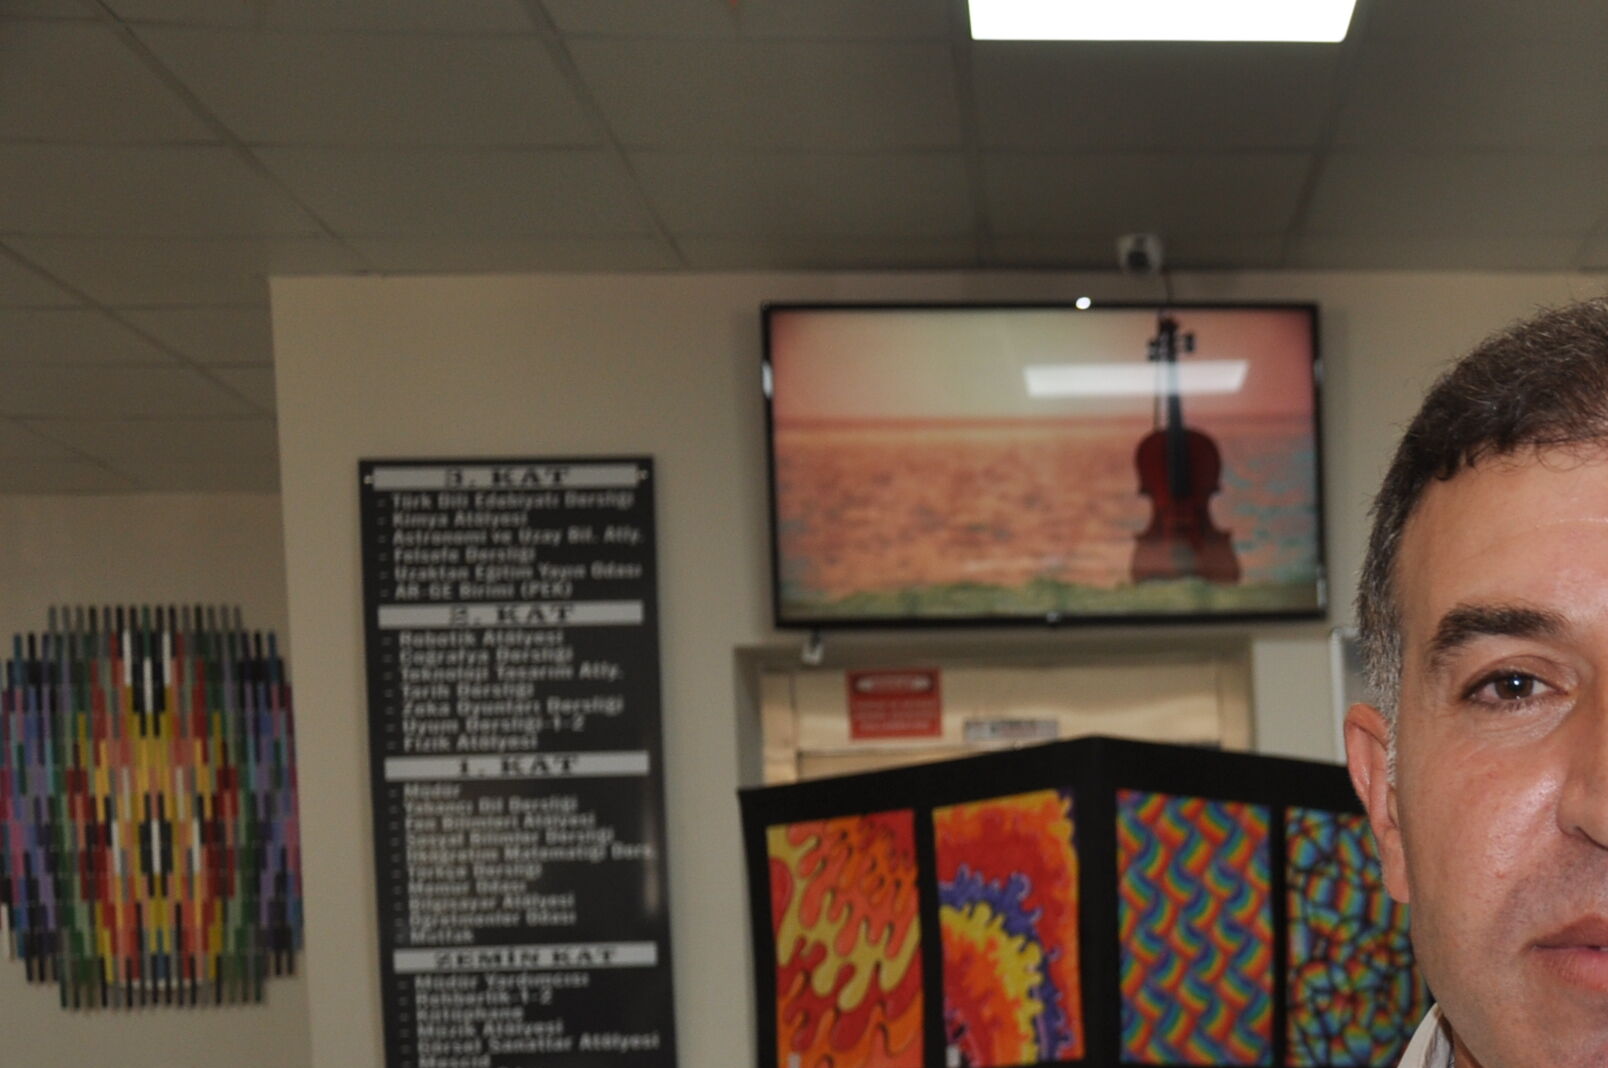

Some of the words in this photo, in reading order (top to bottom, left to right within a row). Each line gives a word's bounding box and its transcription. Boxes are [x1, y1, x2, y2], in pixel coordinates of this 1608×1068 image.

[492, 467, 568, 485] KAT
[393, 510, 448, 529] Kimya
[497, 603, 572, 621] KAT
[403, 733, 450, 751] Fizik
[501, 755, 578, 776] KAT
[552, 949, 615, 964] KAT
